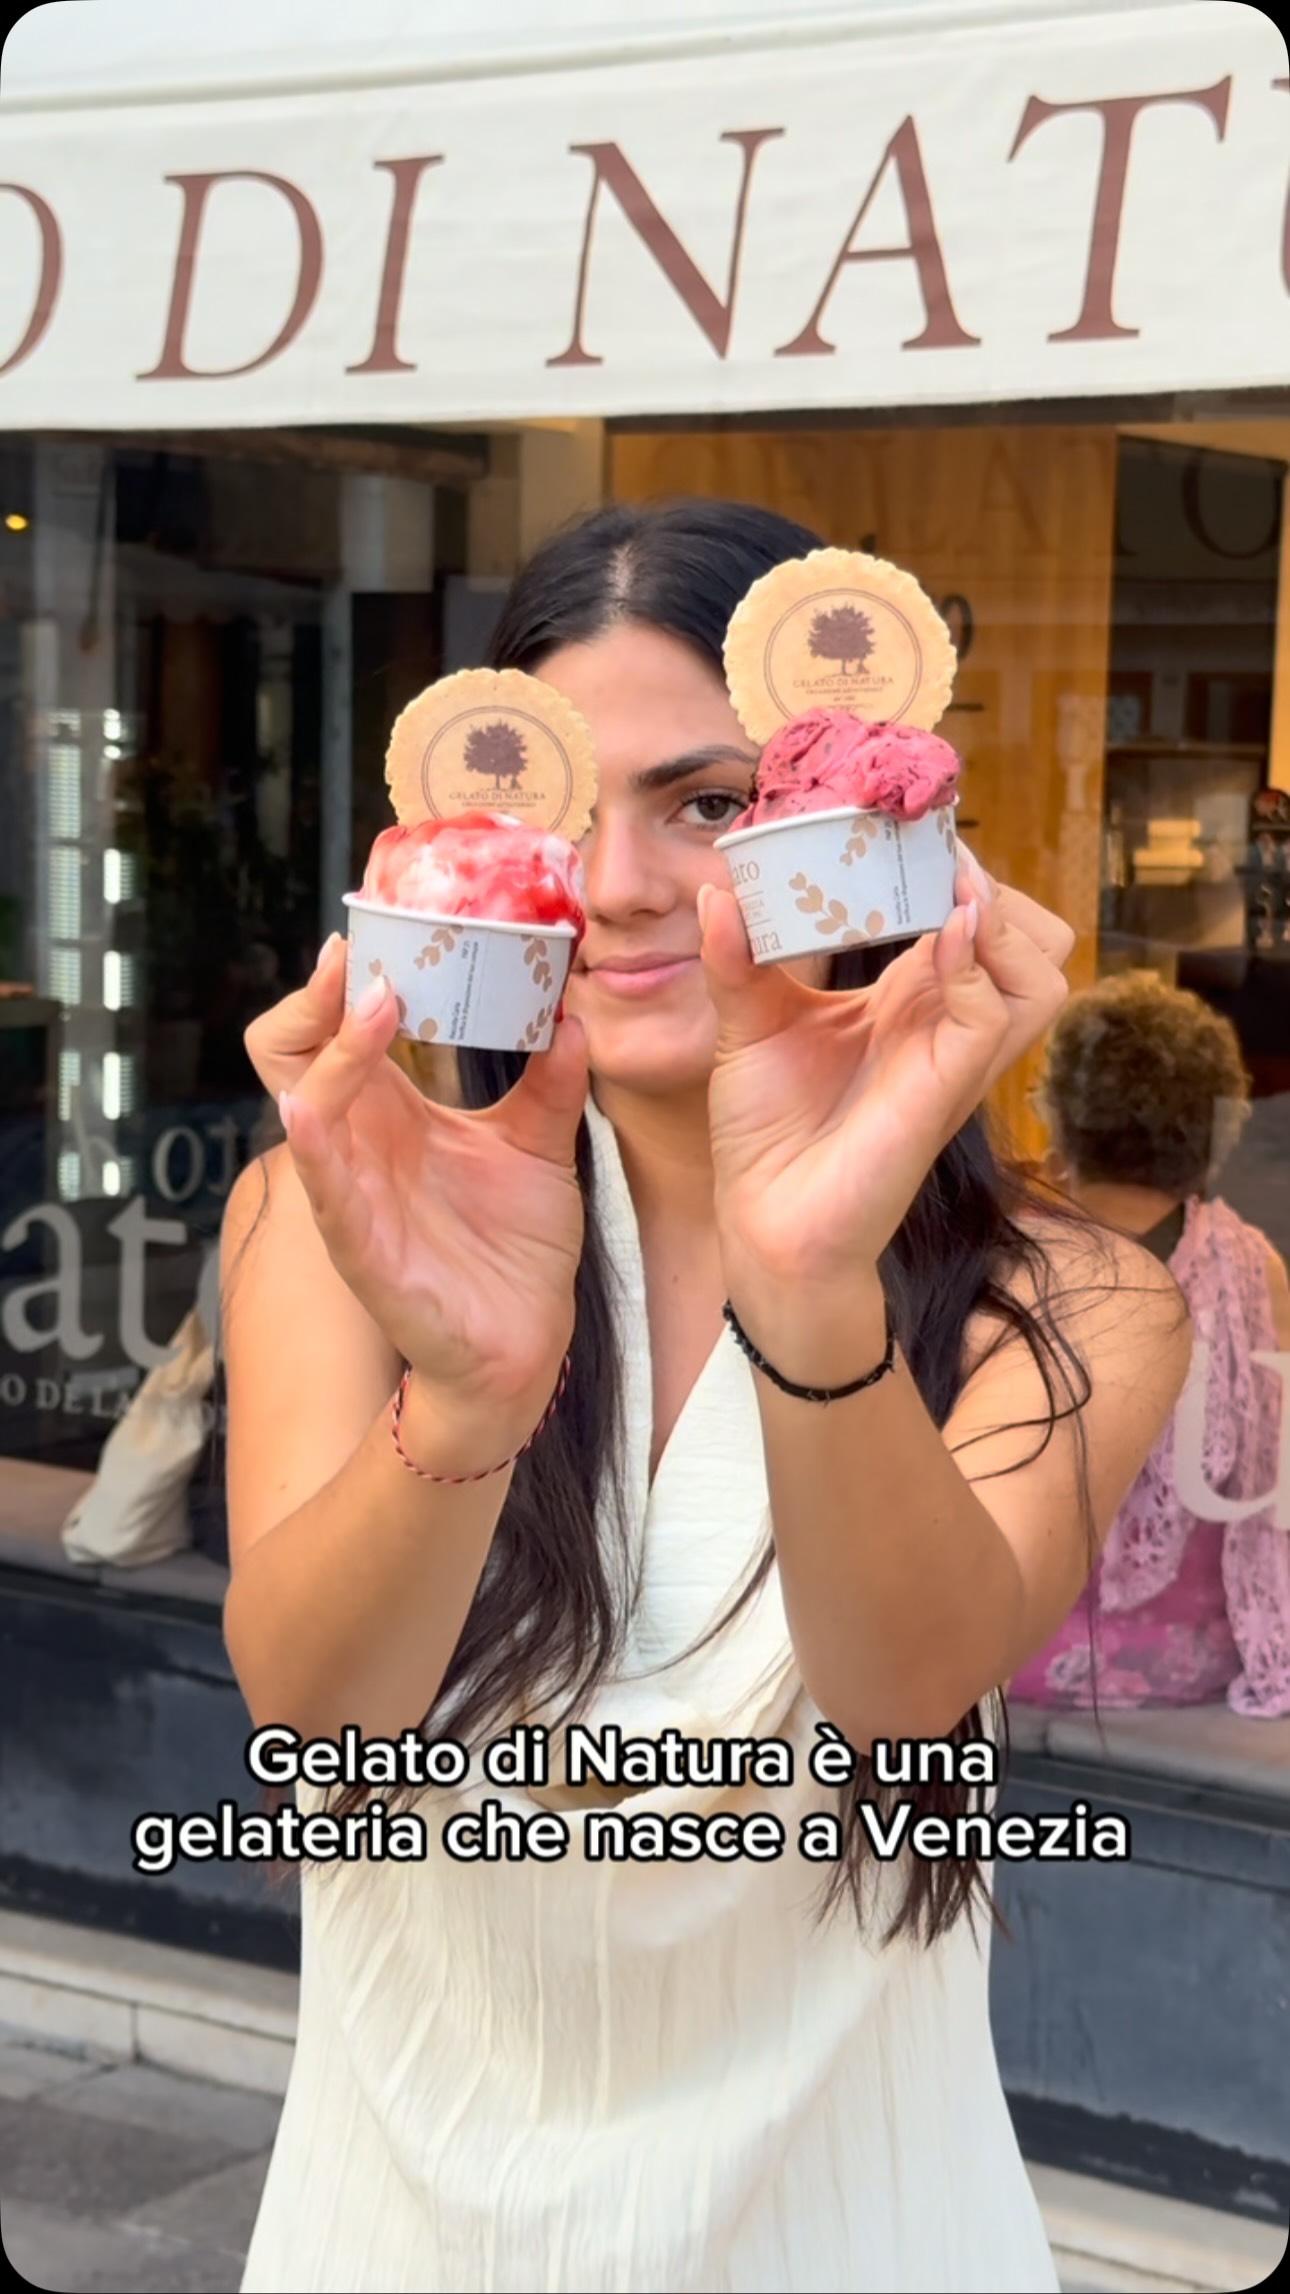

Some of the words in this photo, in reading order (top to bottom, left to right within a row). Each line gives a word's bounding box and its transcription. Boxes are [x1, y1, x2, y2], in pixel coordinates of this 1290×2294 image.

[136, 155, 444, 382] DI
[545, 74, 1290, 368] NAT
[1, 1195, 222, 1372] at
